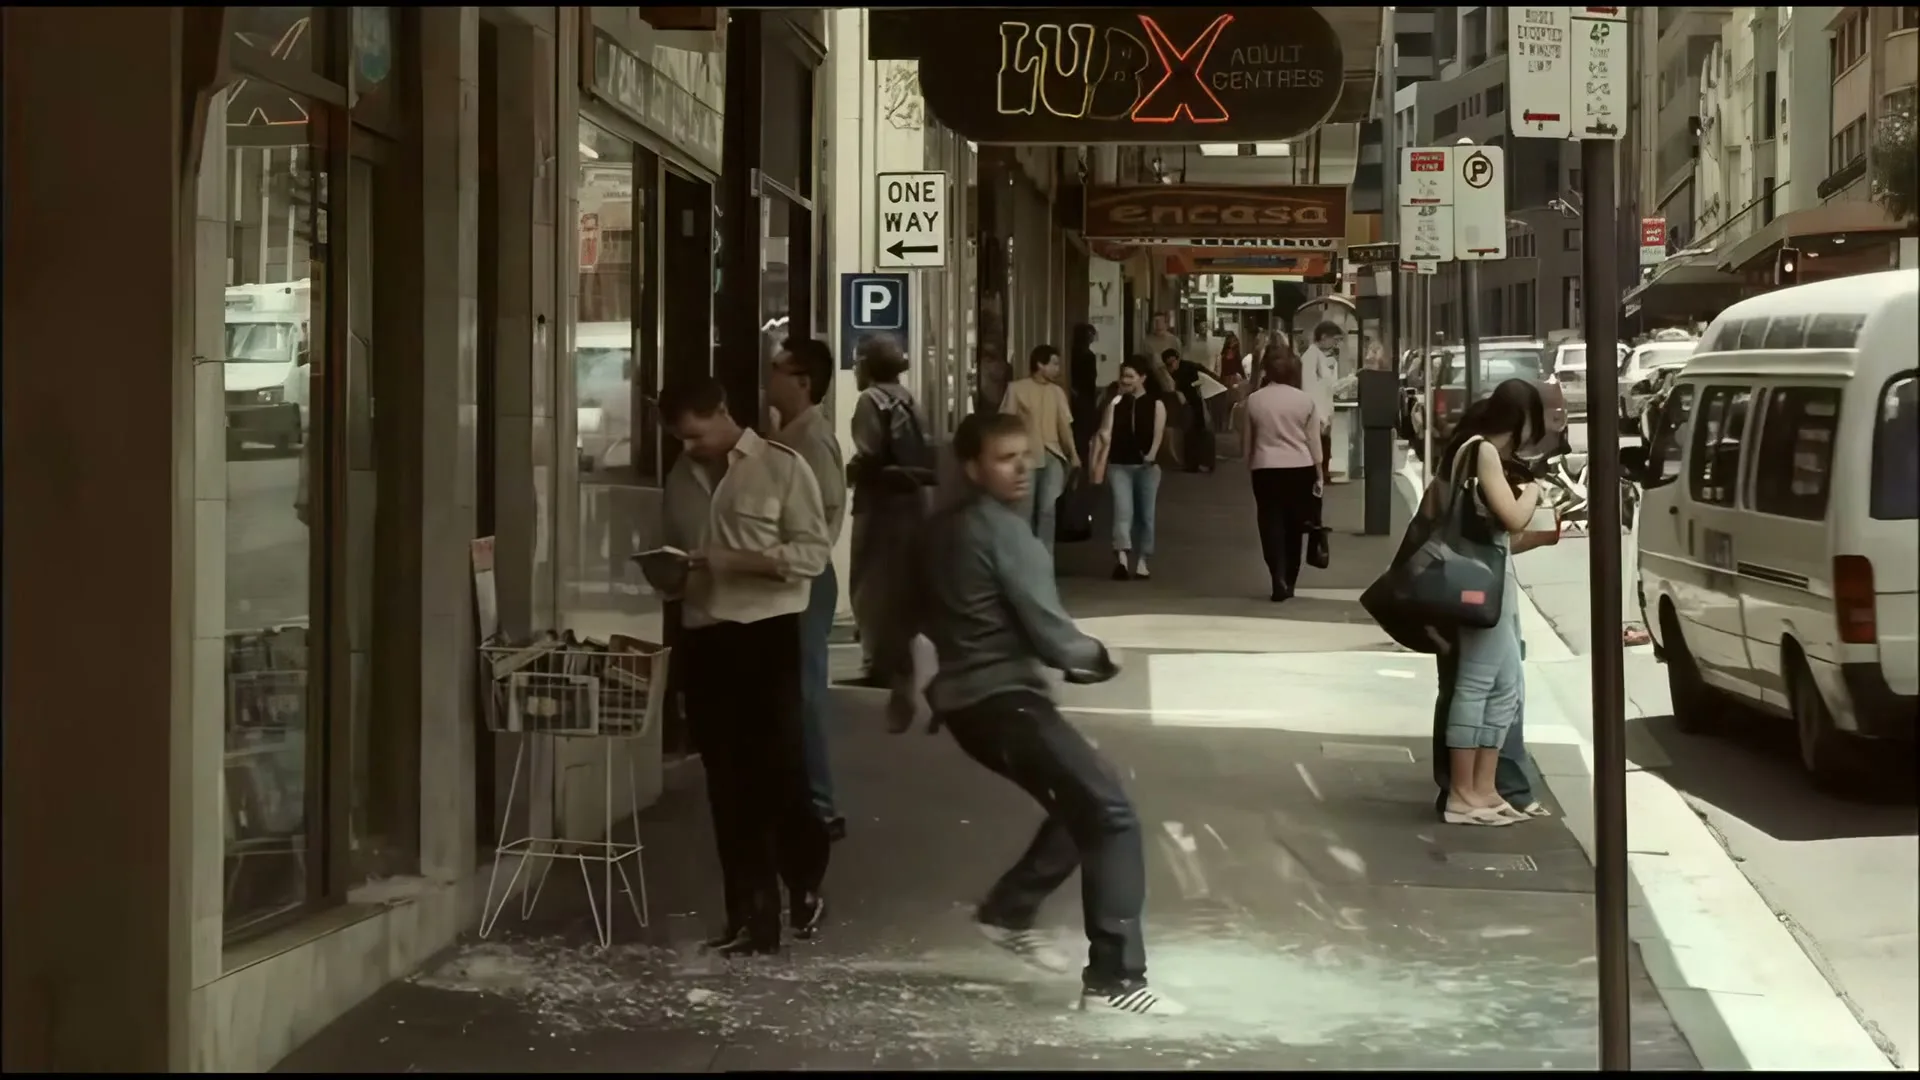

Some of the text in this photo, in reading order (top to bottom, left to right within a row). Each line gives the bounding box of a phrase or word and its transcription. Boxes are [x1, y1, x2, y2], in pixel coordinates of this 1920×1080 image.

[1231, 45, 1303, 67] ADULT
[1212, 69, 1324, 91] CENTRES
[888, 181, 936, 203] ONE
[884, 211, 939, 232] WAY
[1109, 204, 1327, 225] encasa
[862, 285, 892, 323] P
